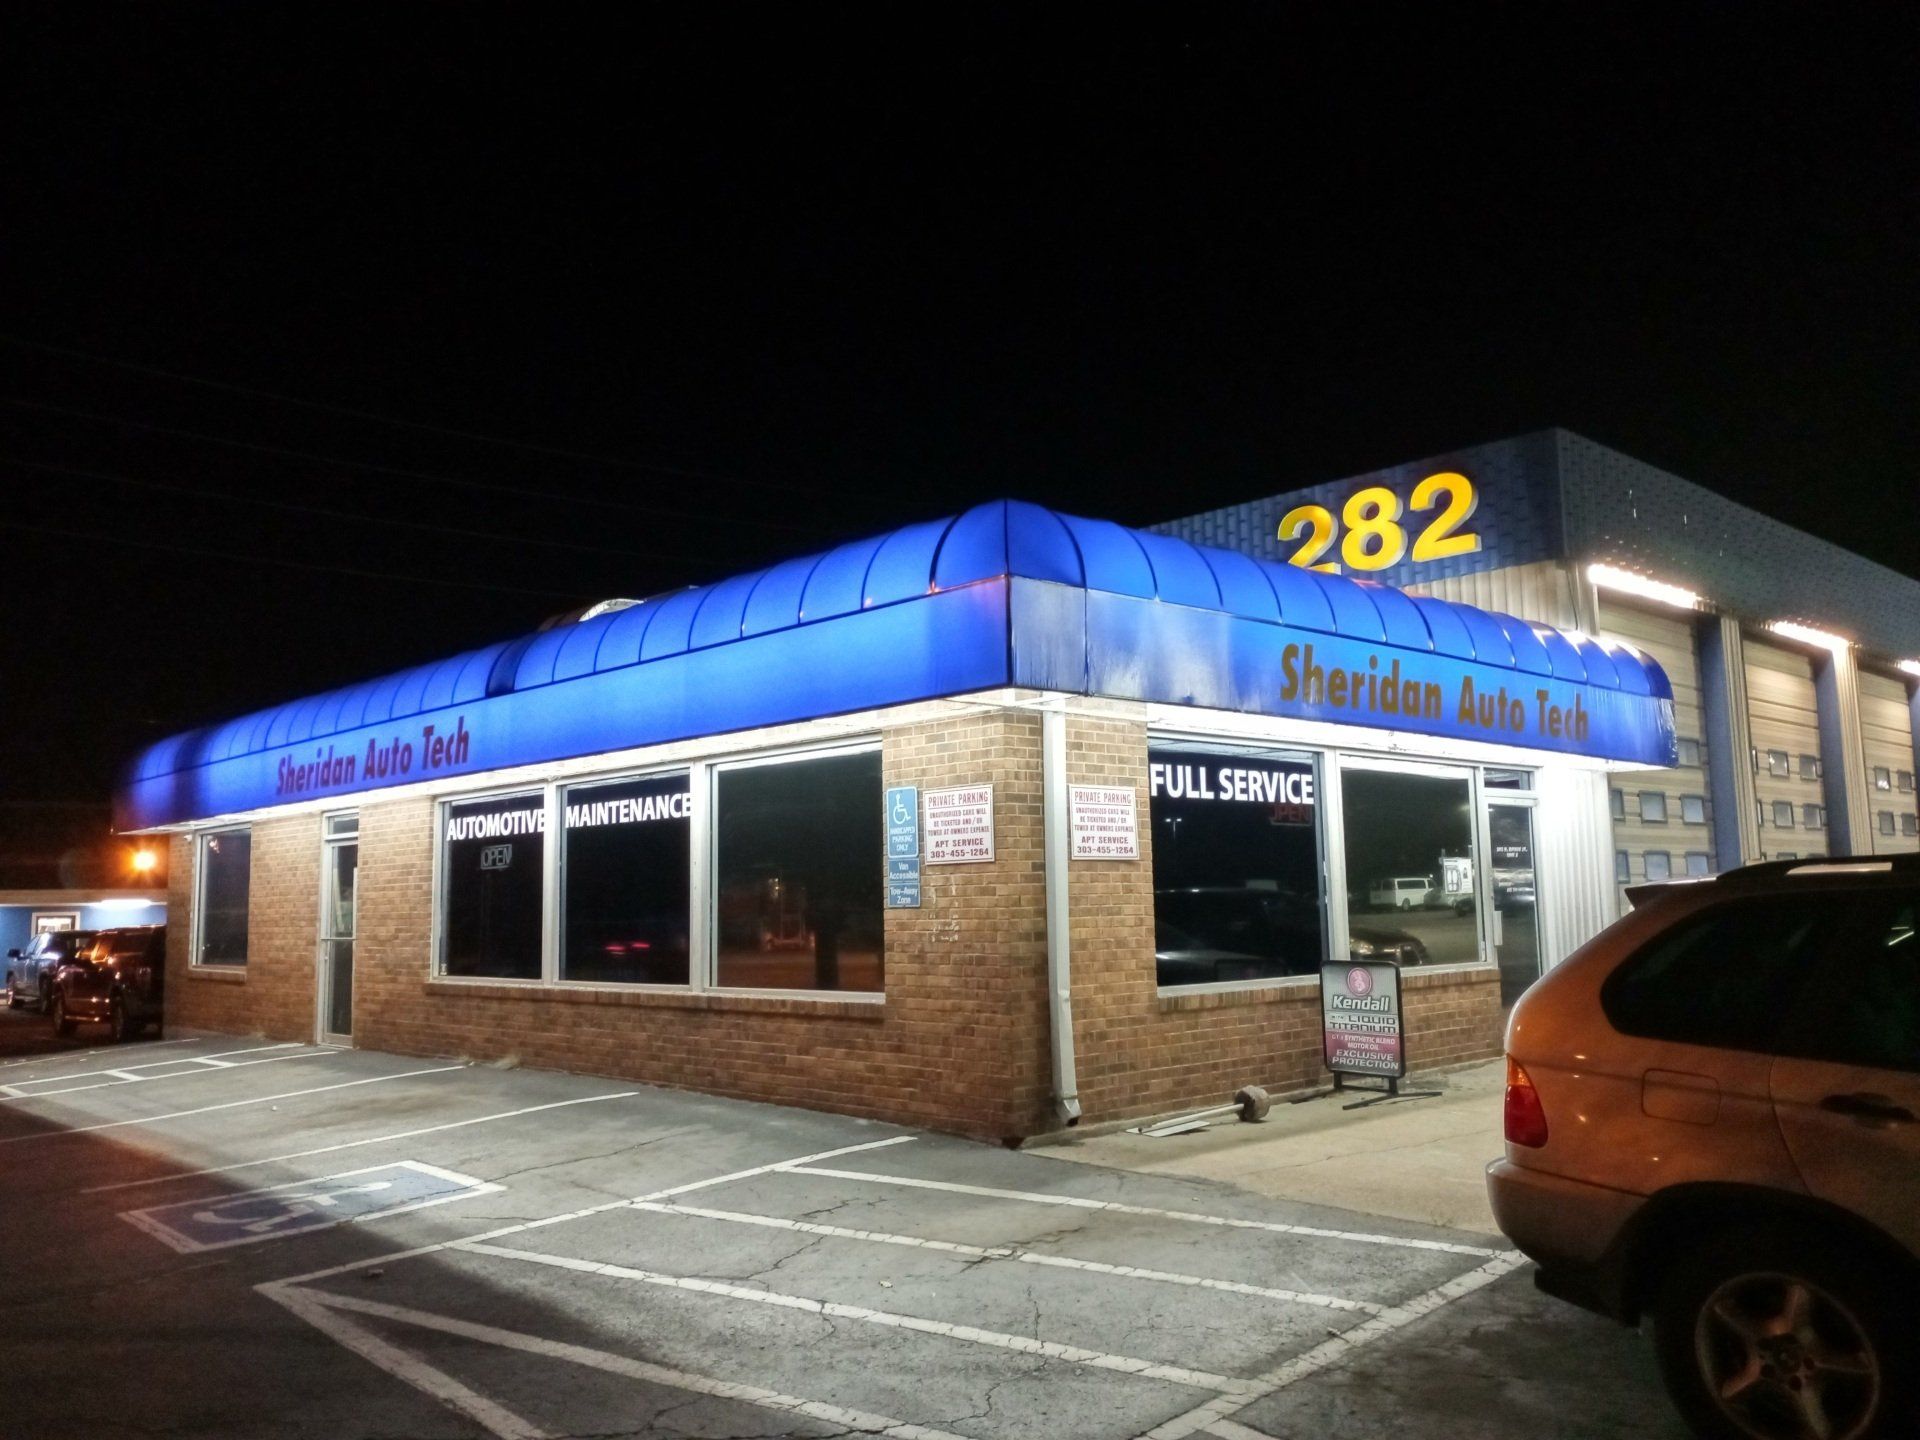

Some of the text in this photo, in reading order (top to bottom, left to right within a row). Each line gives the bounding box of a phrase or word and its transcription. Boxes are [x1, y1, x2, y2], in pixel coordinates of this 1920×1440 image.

[1278, 472, 1482, 575] 282
[1281, 643, 1589, 741] Sheridan Auto Tech
[276, 716, 470, 795] Sheridan Auto Tech
[1150, 763, 1314, 804] FULL SERVICE
[928, 791, 988, 807] PRIVATE PARKING
[1075, 791, 1131, 804] PRIVATE PARKING
[446, 793, 692, 841] AUTOMOTIVE MAINTENANCE
[892, 835, 913, 843] PARKING
[935, 838, 984, 848] APT SERVICE
[1098, 836, 1128, 844] SERVICE
[482, 847, 512, 867] OPEN
[898, 862, 909, 870] Van
[889, 872, 918, 880] Accessible
[890, 887, 918, 897] Tow-Away
[896, 895, 911, 904] Zone
[1332, 995, 1390, 1012] Kendall
[1348, 1015, 1395, 1025] LIQUID
[1329, 1021, 1396, 1033] TITANIUM
[1344, 1035, 1375, 1043] SYNTHETIC
[1347, 1042, 1369, 1050] MOTOR
[1336, 1049, 1394, 1061] EXCLUSIVE
[1331, 1056, 1399, 1070] PROTECTION
